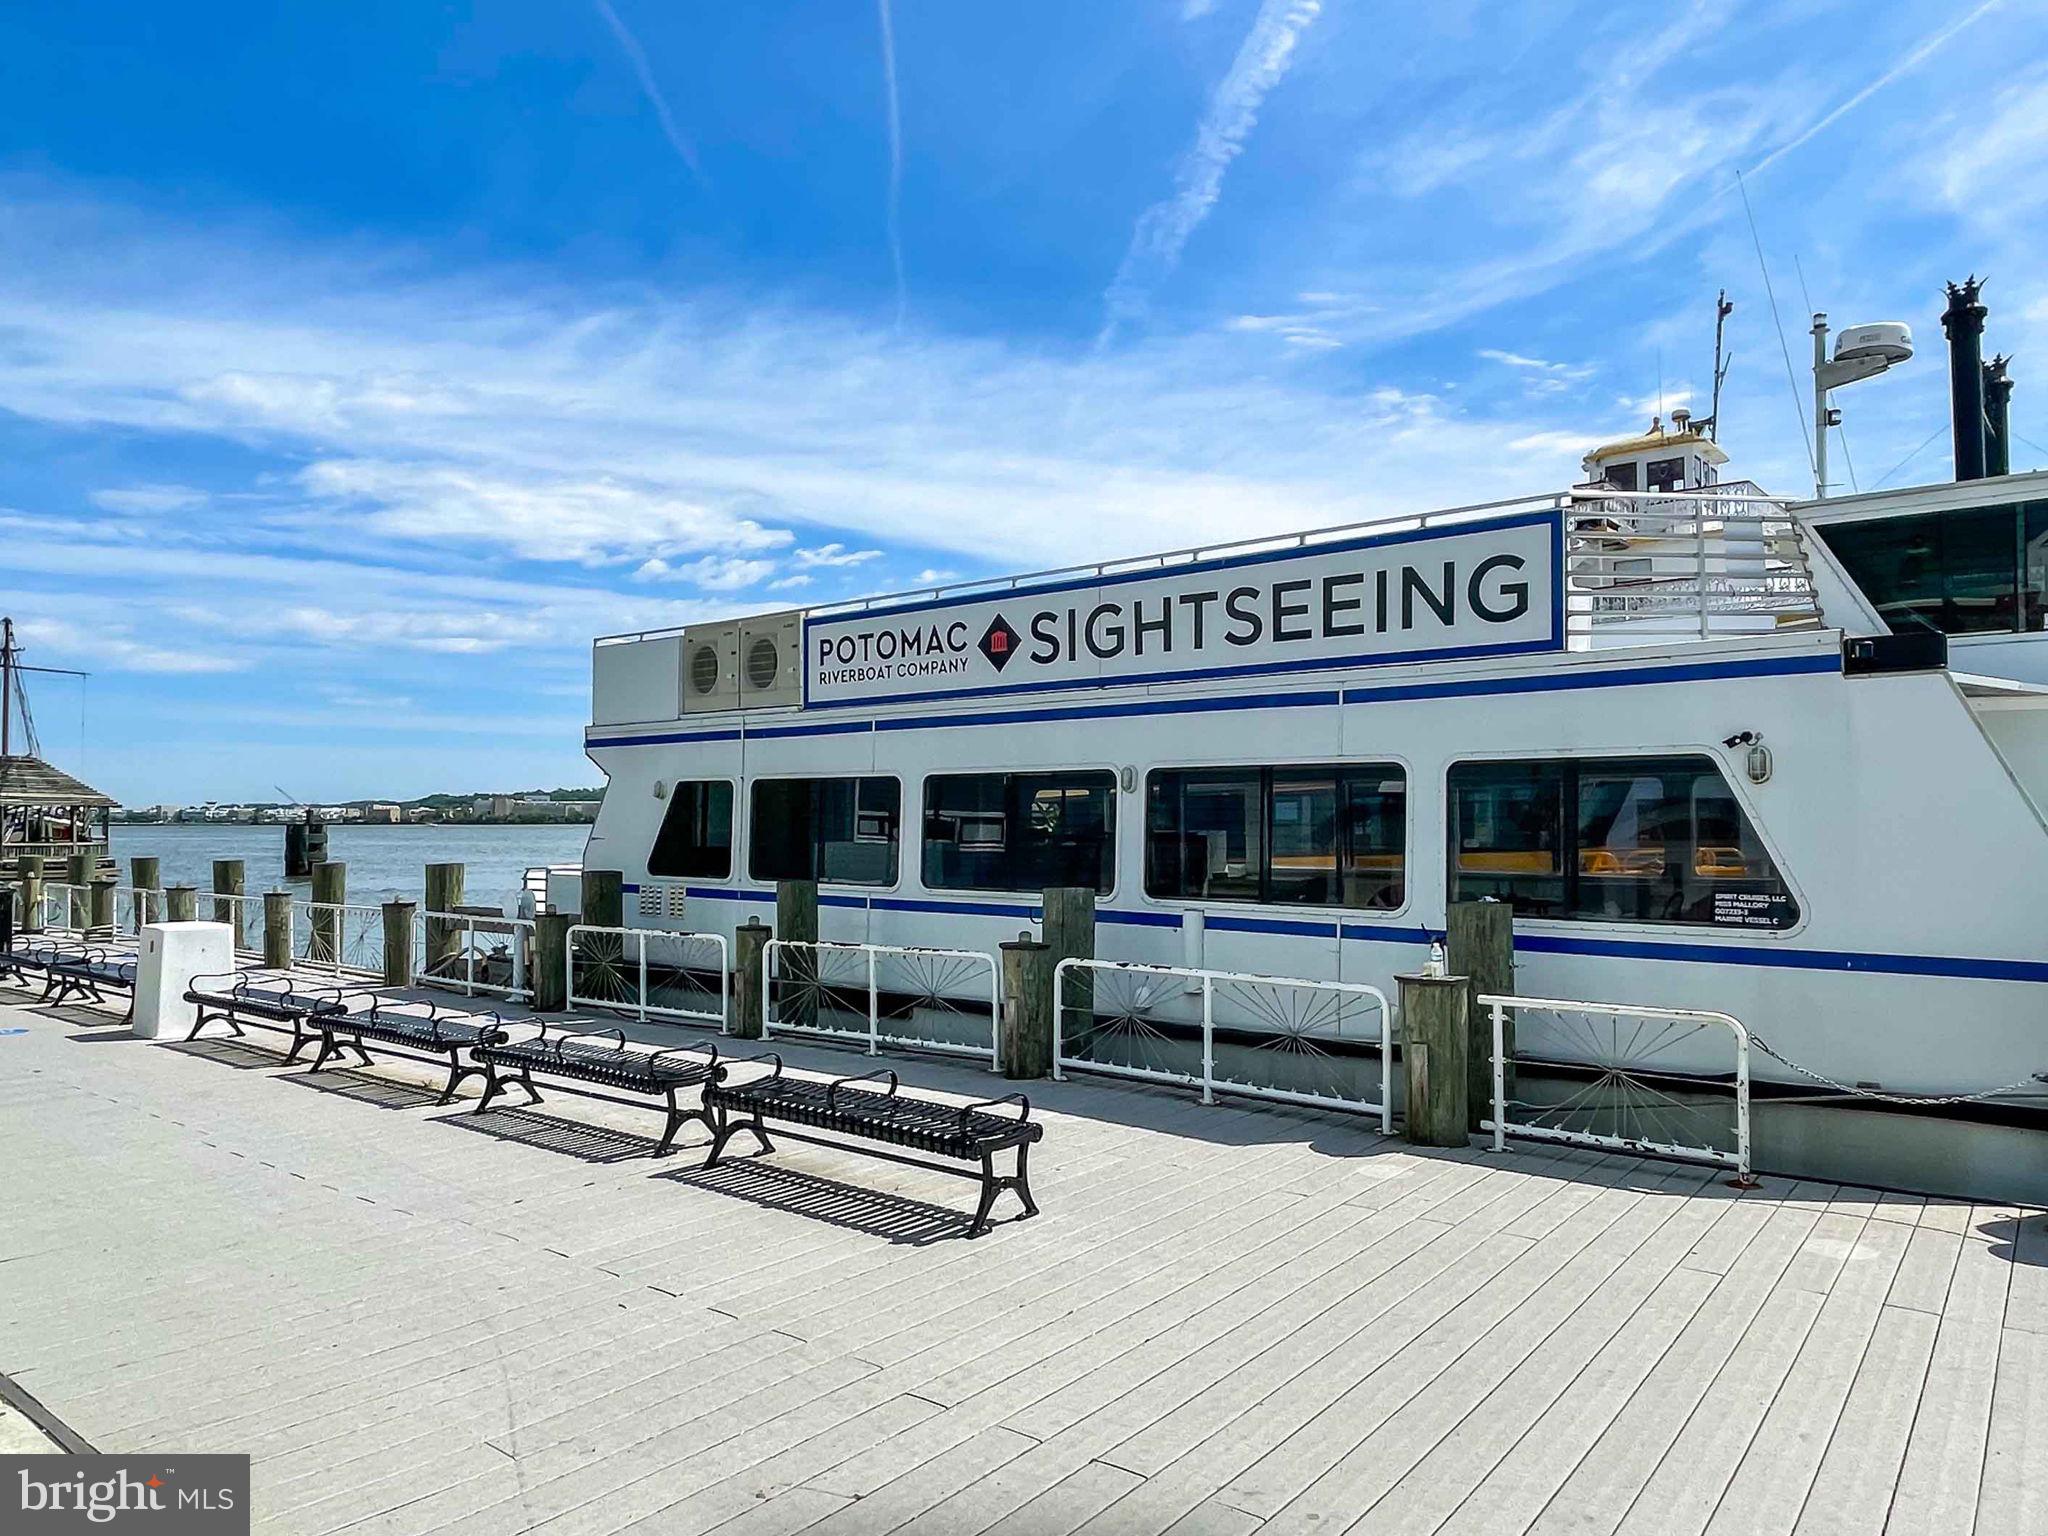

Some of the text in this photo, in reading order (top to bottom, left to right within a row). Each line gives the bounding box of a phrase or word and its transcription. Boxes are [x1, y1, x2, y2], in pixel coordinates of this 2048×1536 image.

[1029, 554, 1530, 665] SIGHTSEEING
[819, 621, 968, 666] POTOMAC
[819, 657, 969, 685] RIVERBOAT COMPANY
